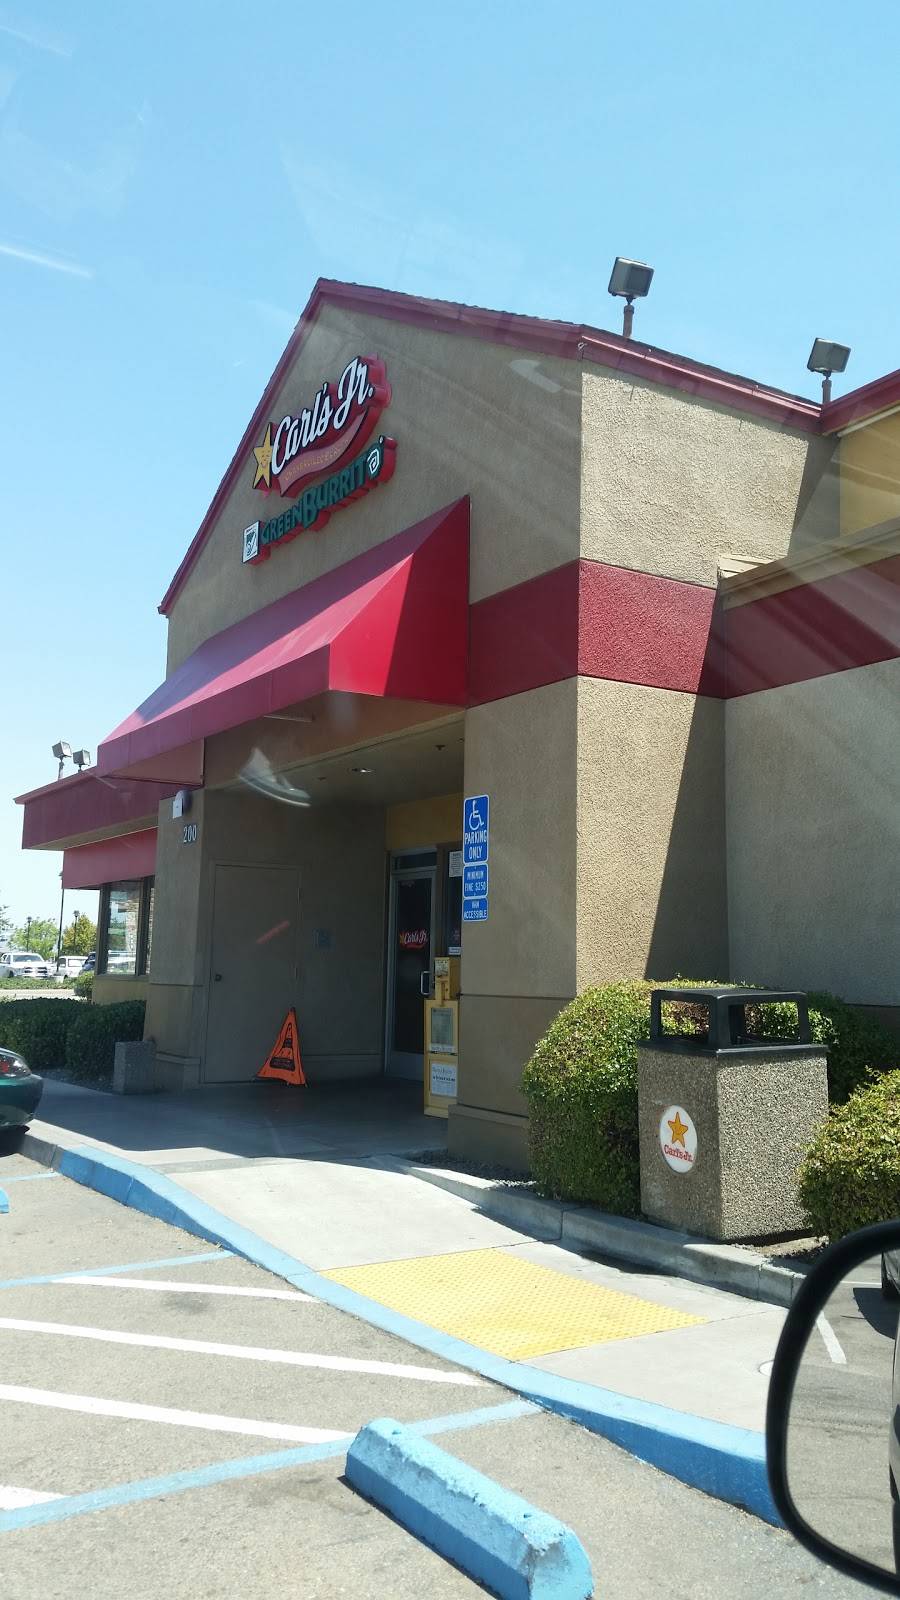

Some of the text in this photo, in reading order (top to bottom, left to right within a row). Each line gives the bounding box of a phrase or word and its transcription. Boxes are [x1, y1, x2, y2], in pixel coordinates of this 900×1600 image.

[271, 382, 334, 475] Carl's
[333, 356, 375, 430] Jr.
[183, 824, 197, 843] 200
[464, 829, 487, 845] PARKING
[468, 846, 483, 860] ONLY
[464, 881, 487, 892] FINE $250
[463, 909, 487, 919] ACCESSIBLE
